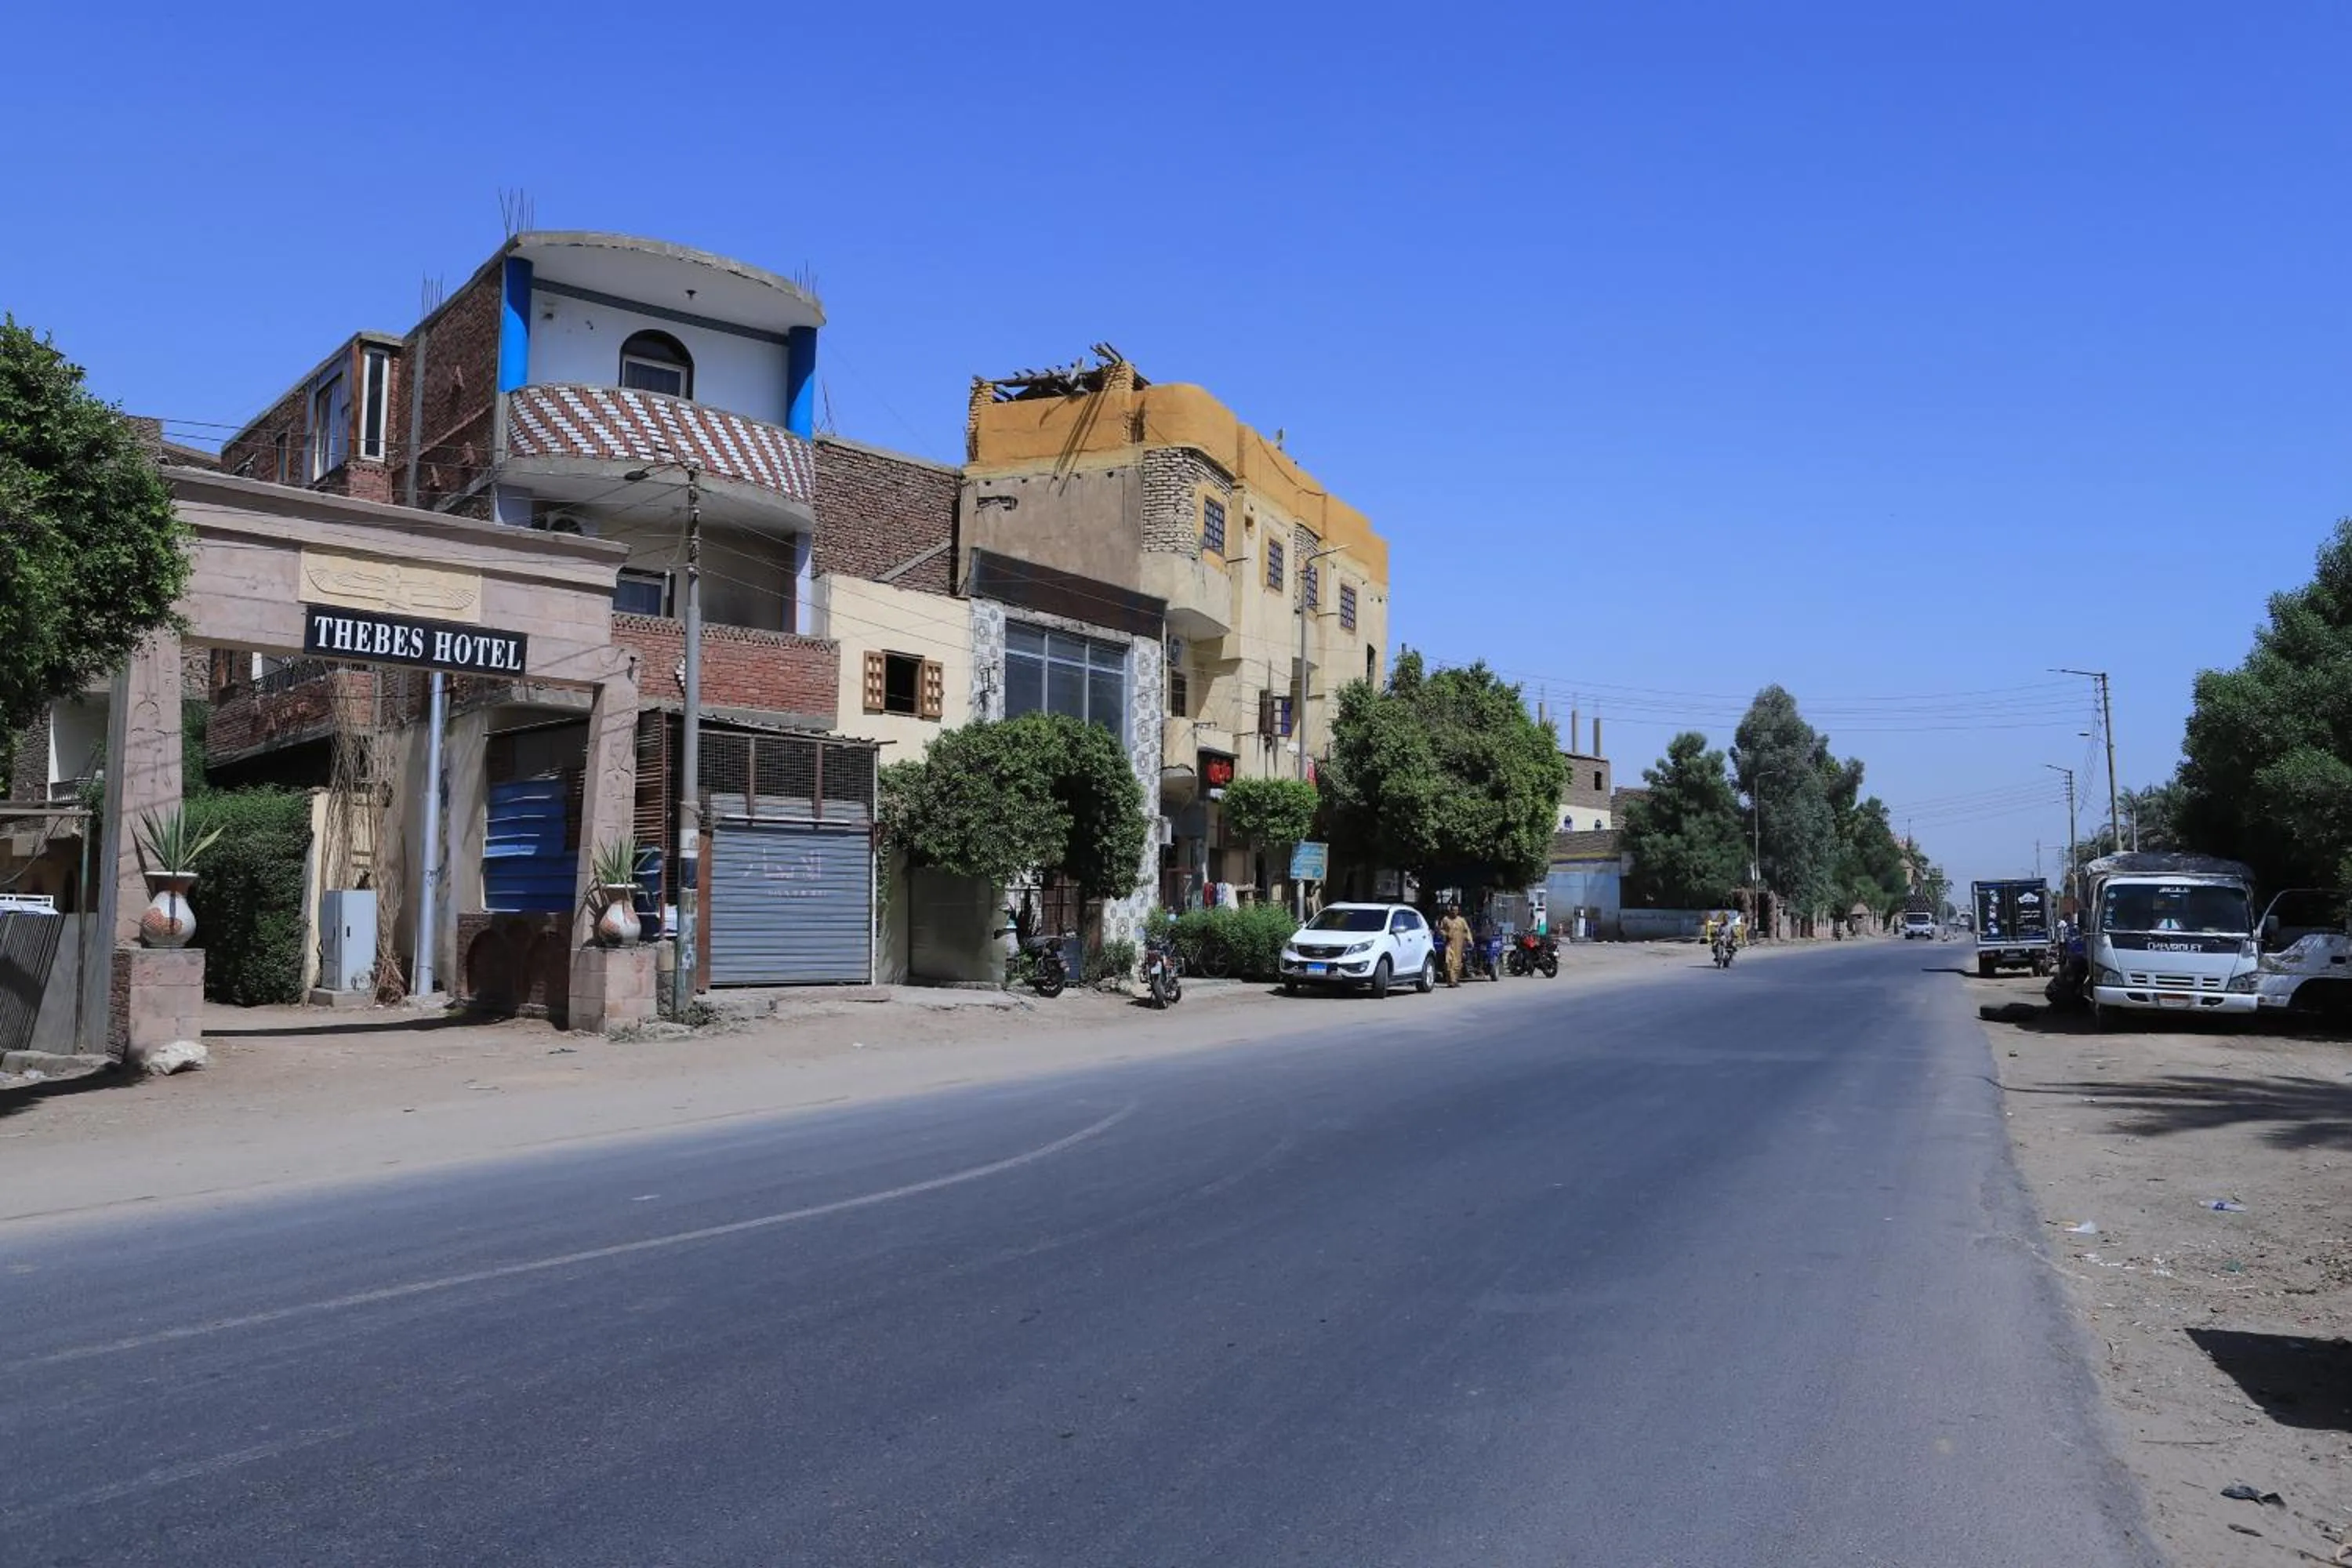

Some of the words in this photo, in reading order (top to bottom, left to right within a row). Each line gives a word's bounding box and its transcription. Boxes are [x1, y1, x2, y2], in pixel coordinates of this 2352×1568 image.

[315, 616, 424, 658] THEBES
[434, 632, 521, 670] HOTEL
[2147, 942, 2203, 952] CHEVROLET
